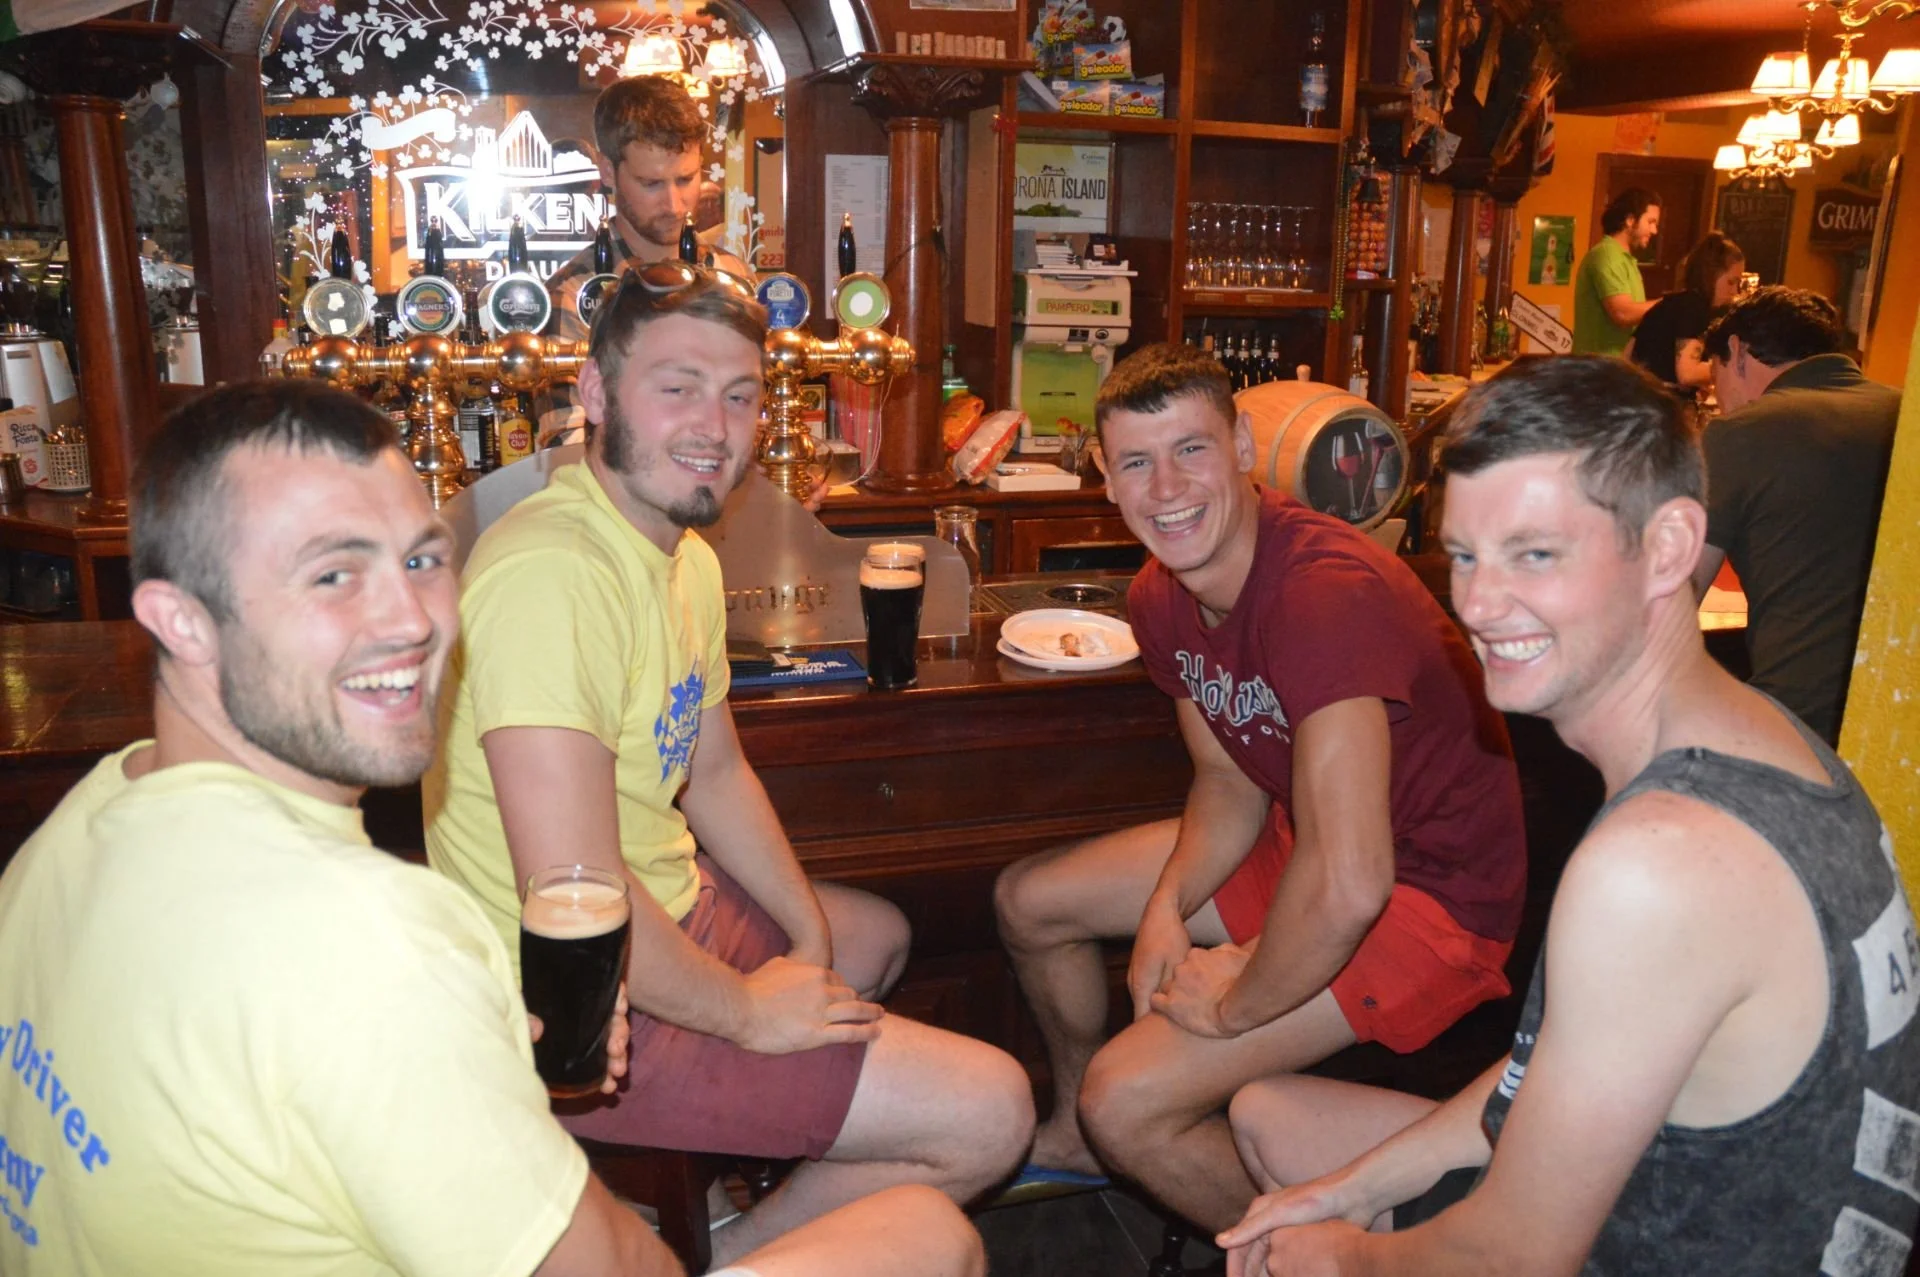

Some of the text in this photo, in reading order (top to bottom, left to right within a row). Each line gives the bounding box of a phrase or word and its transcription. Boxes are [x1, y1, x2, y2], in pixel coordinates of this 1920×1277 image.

[1080, 63, 1125, 77] goleador
[1060, 99, 1103, 111] goleador
[1114, 103, 1158, 115] goleador
[1061, 178, 1106, 200] ISLAND
[424, 182, 610, 242] KILKEN
[1817, 202, 1879, 232] GRIM
[408, 301, 452, 312] AGNERS
[1046, 303, 1089, 312] PAMPERO
[11, 1018, 111, 1174] Driver
